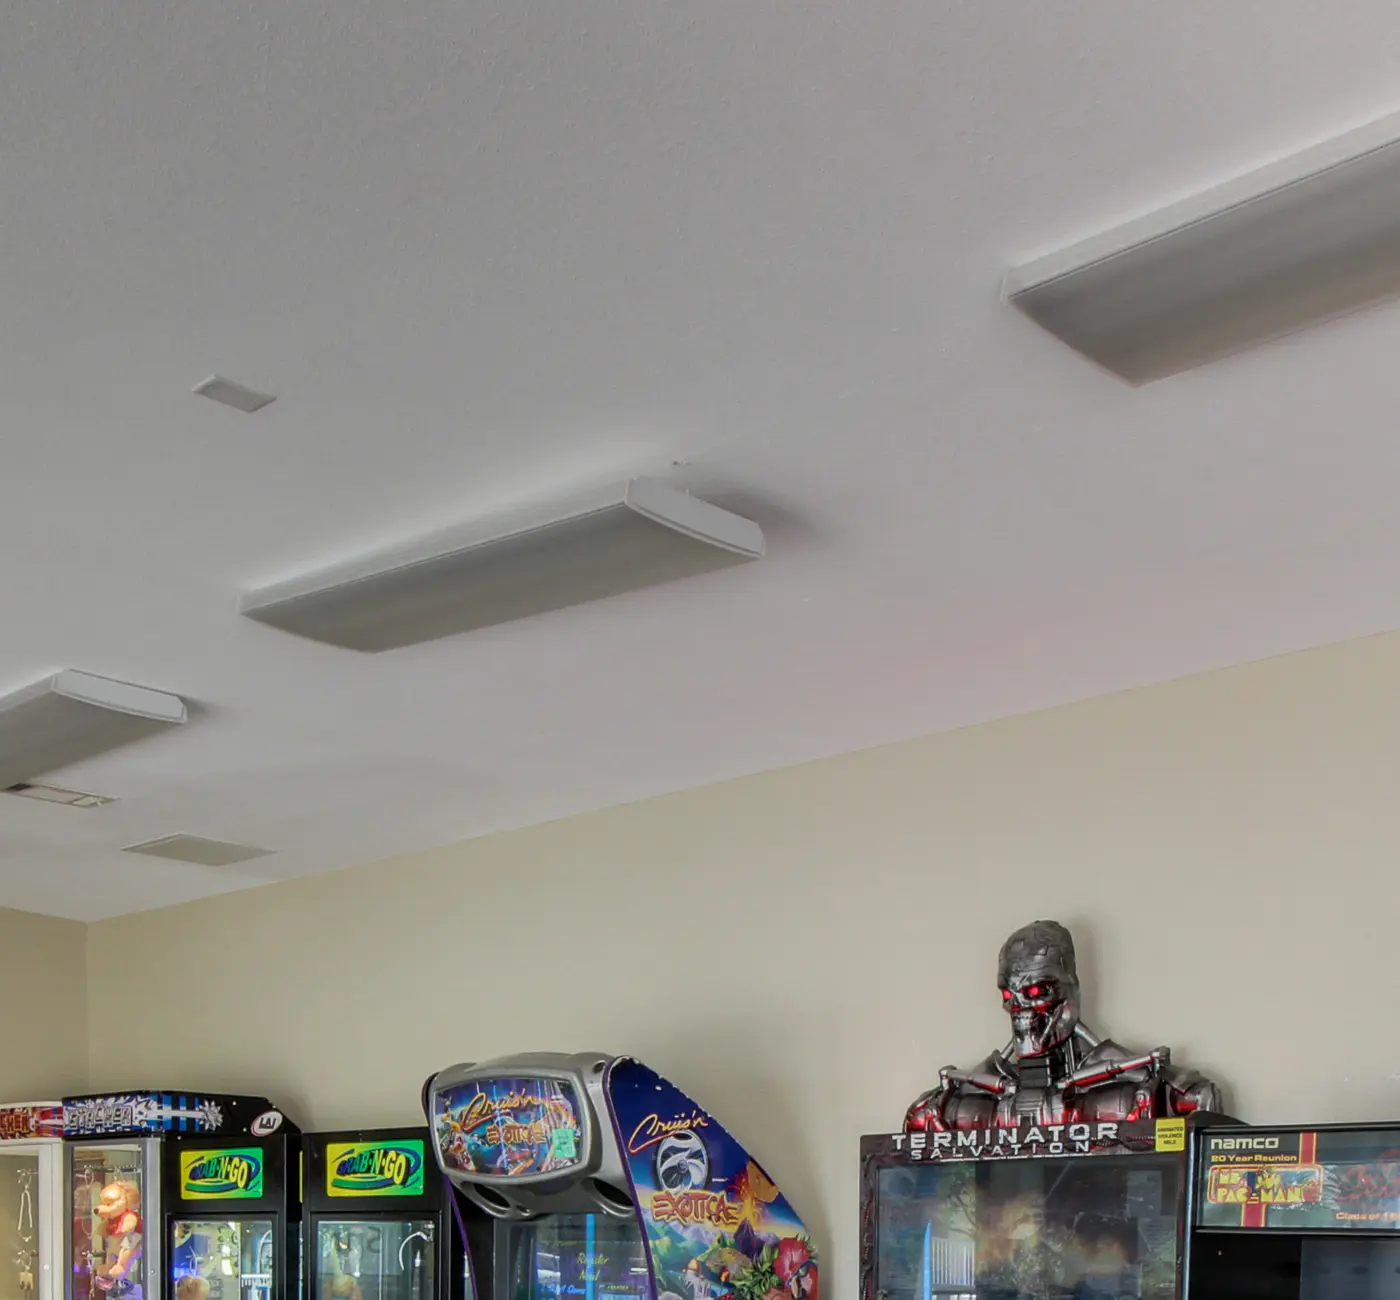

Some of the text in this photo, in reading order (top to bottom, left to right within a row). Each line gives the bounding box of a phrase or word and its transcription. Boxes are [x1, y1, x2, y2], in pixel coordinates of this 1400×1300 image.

[892, 1122, 1118, 1150] TERMINATOR
[1210, 1138, 1279, 1149] namco
[911, 1141, 1089, 1161] SALVATION
[652, 1190, 738, 1225] EXOTICA
